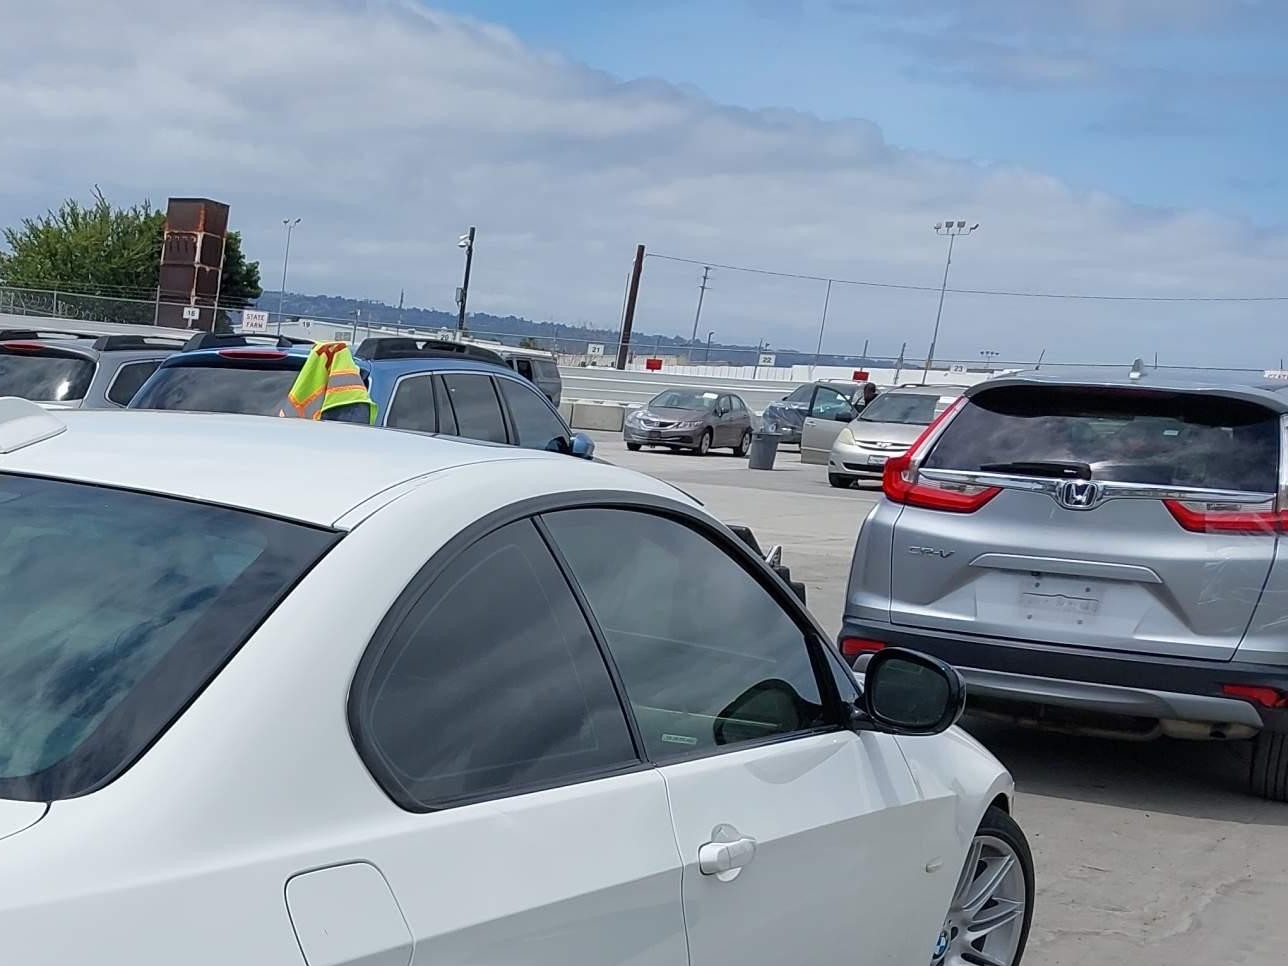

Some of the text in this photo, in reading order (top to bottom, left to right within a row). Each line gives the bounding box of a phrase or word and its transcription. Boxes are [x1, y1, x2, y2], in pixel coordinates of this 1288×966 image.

[246, 313, 264, 321] STATE
[245, 321, 263, 329] FARM
[762, 356, 772, 364] 22
[908, 545, 956, 559] CR-V
